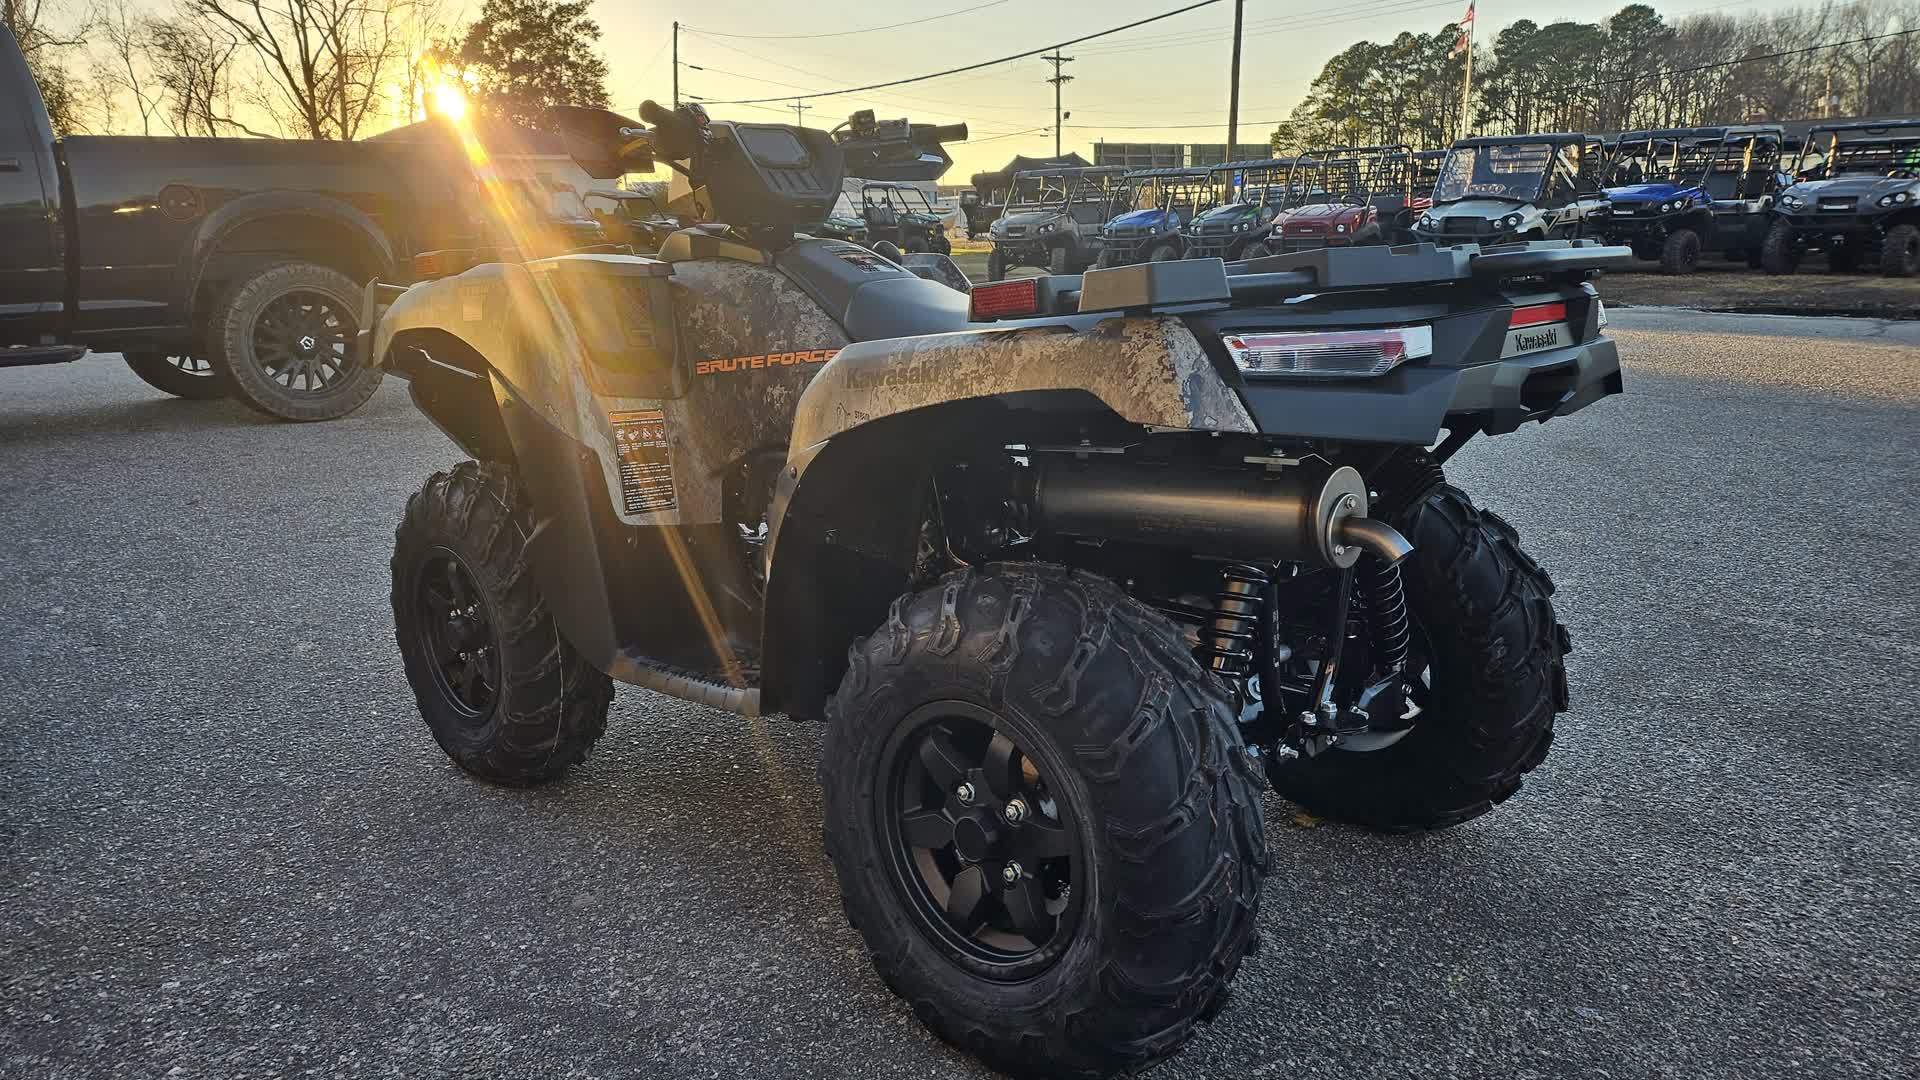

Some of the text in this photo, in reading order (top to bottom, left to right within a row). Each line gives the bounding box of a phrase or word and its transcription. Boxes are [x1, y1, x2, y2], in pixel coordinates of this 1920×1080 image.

[1515, 329, 1557, 351] Kawasaki
[696, 348, 842, 376] BRUTE FORCE
